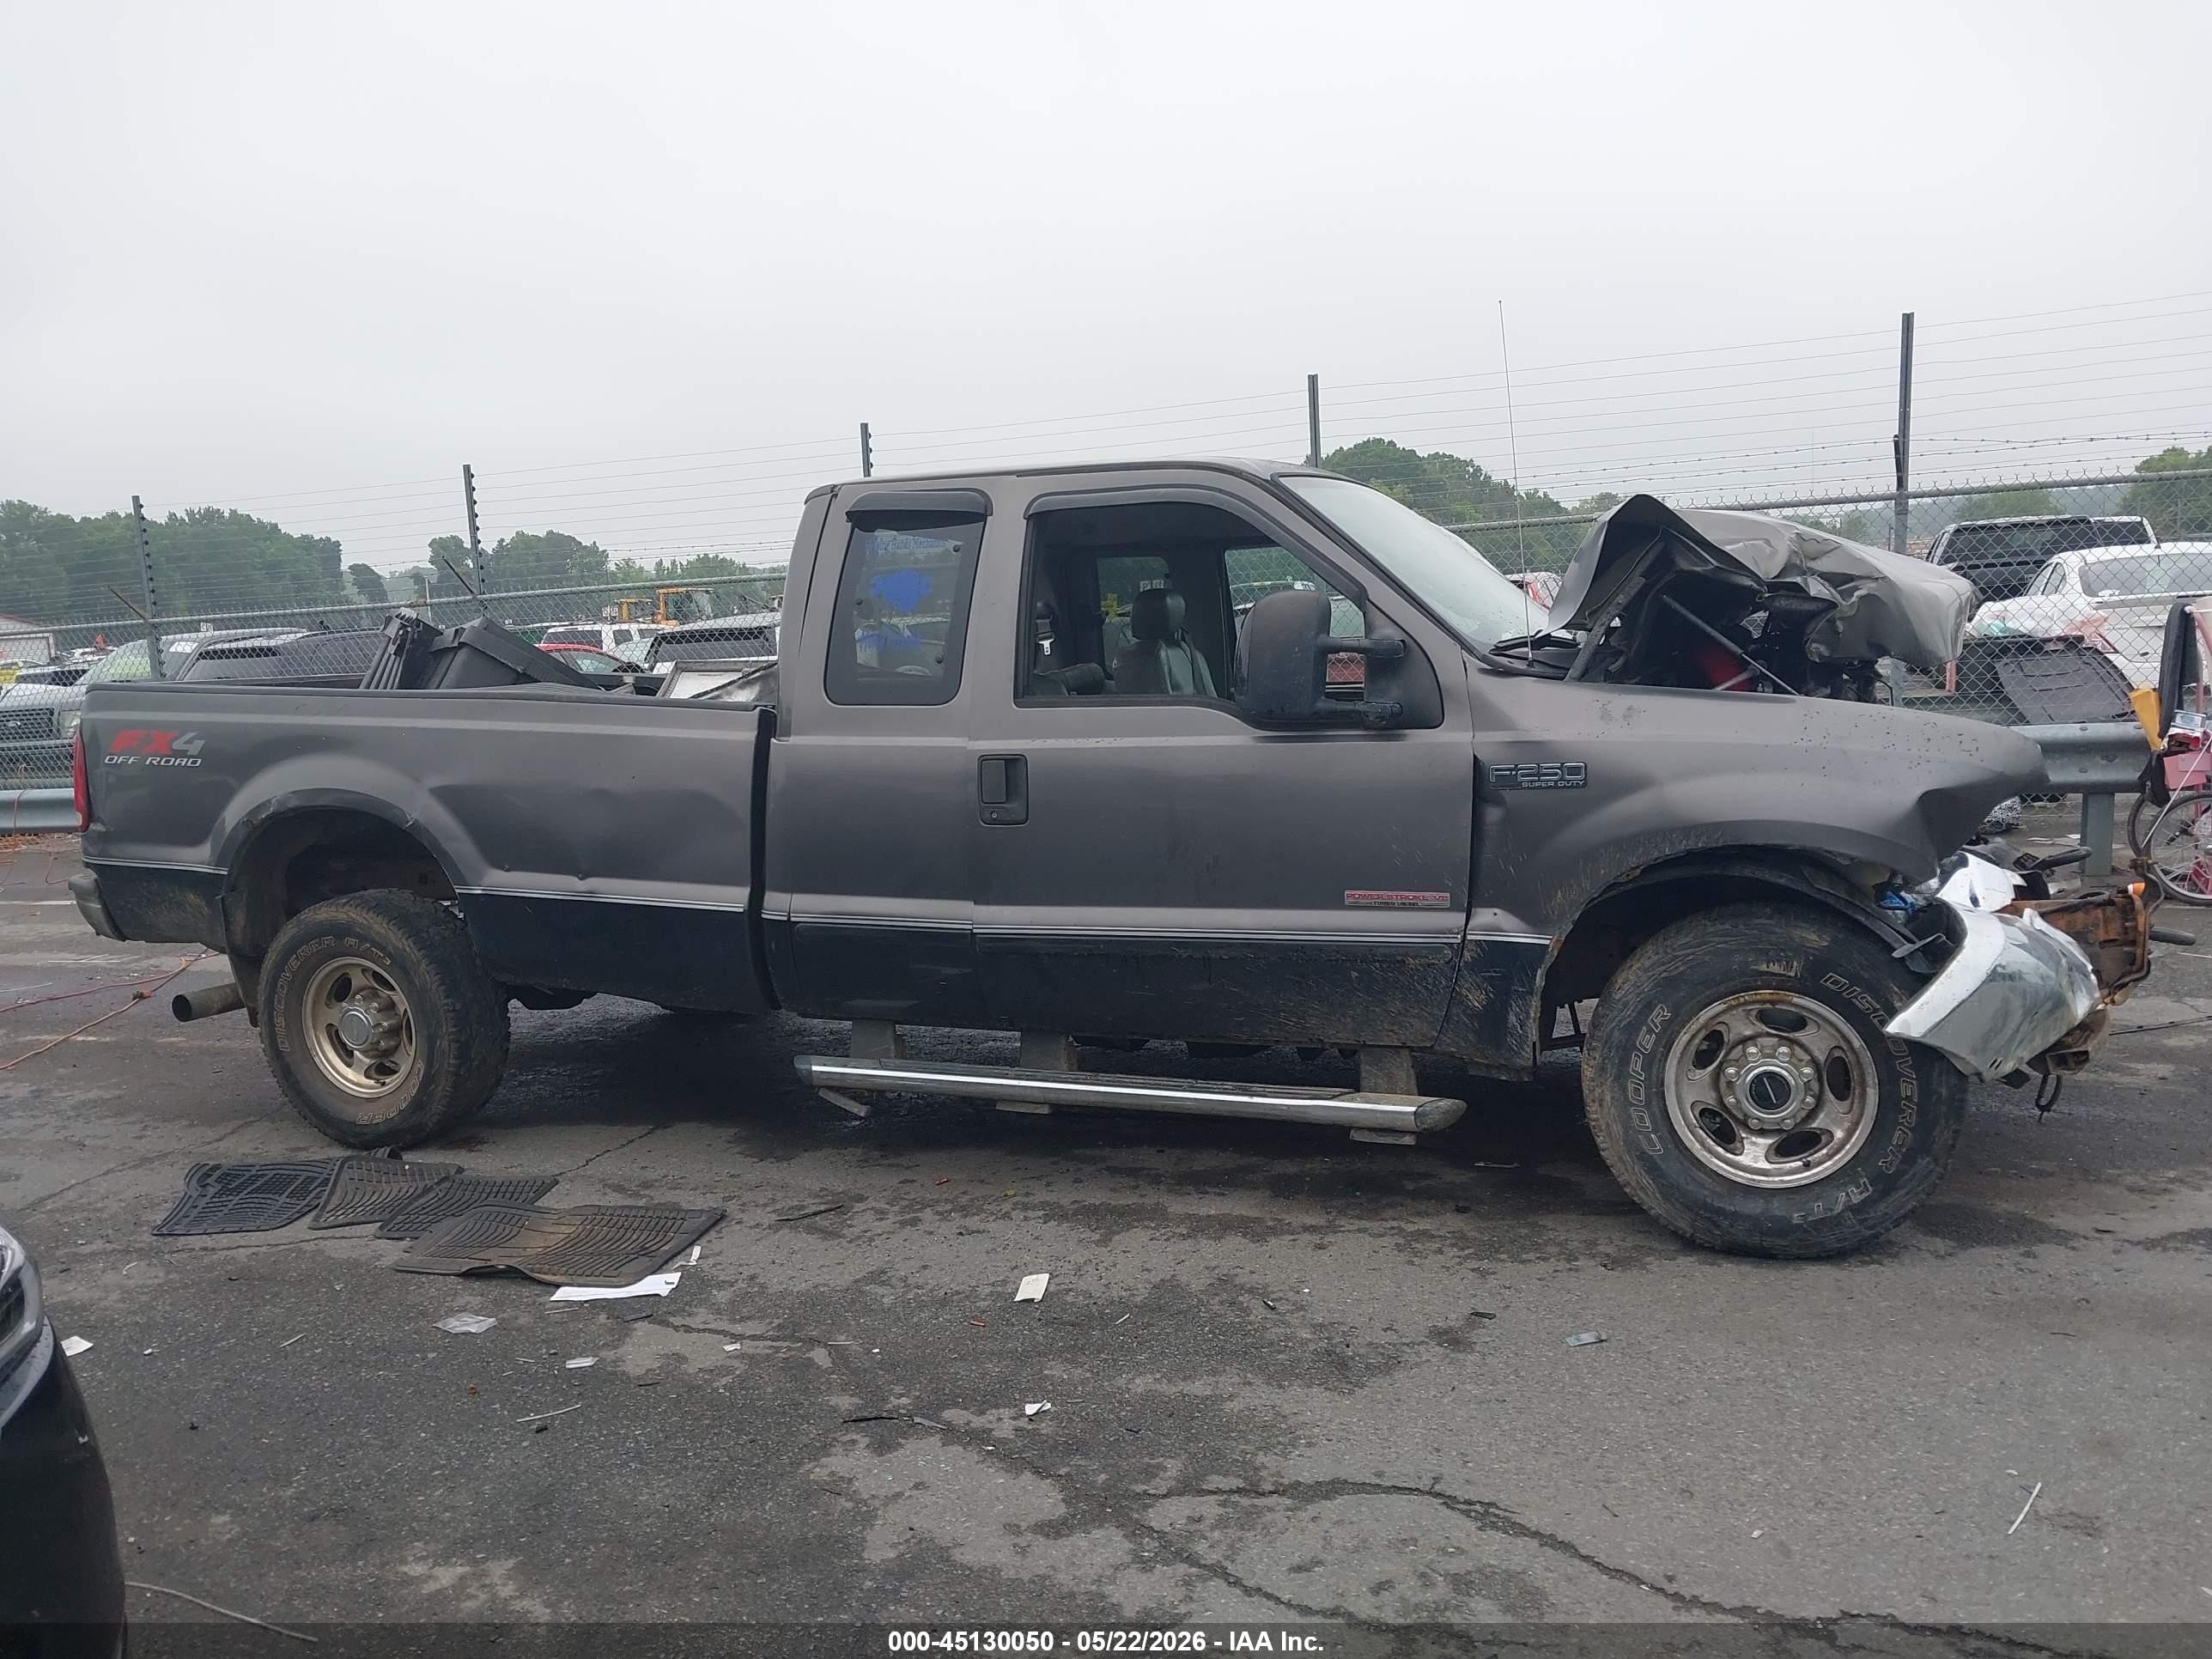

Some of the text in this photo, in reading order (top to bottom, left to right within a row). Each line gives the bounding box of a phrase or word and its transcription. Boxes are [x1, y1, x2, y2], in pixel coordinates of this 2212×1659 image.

[104, 756, 203, 767] OFF ROAD
[109, 729, 206, 756] FX4
[274, 936, 336, 1052] DISCOVERER
[356, 1060, 426, 1125] COOPER
[1628, 1004, 1672, 1155] COOPER
